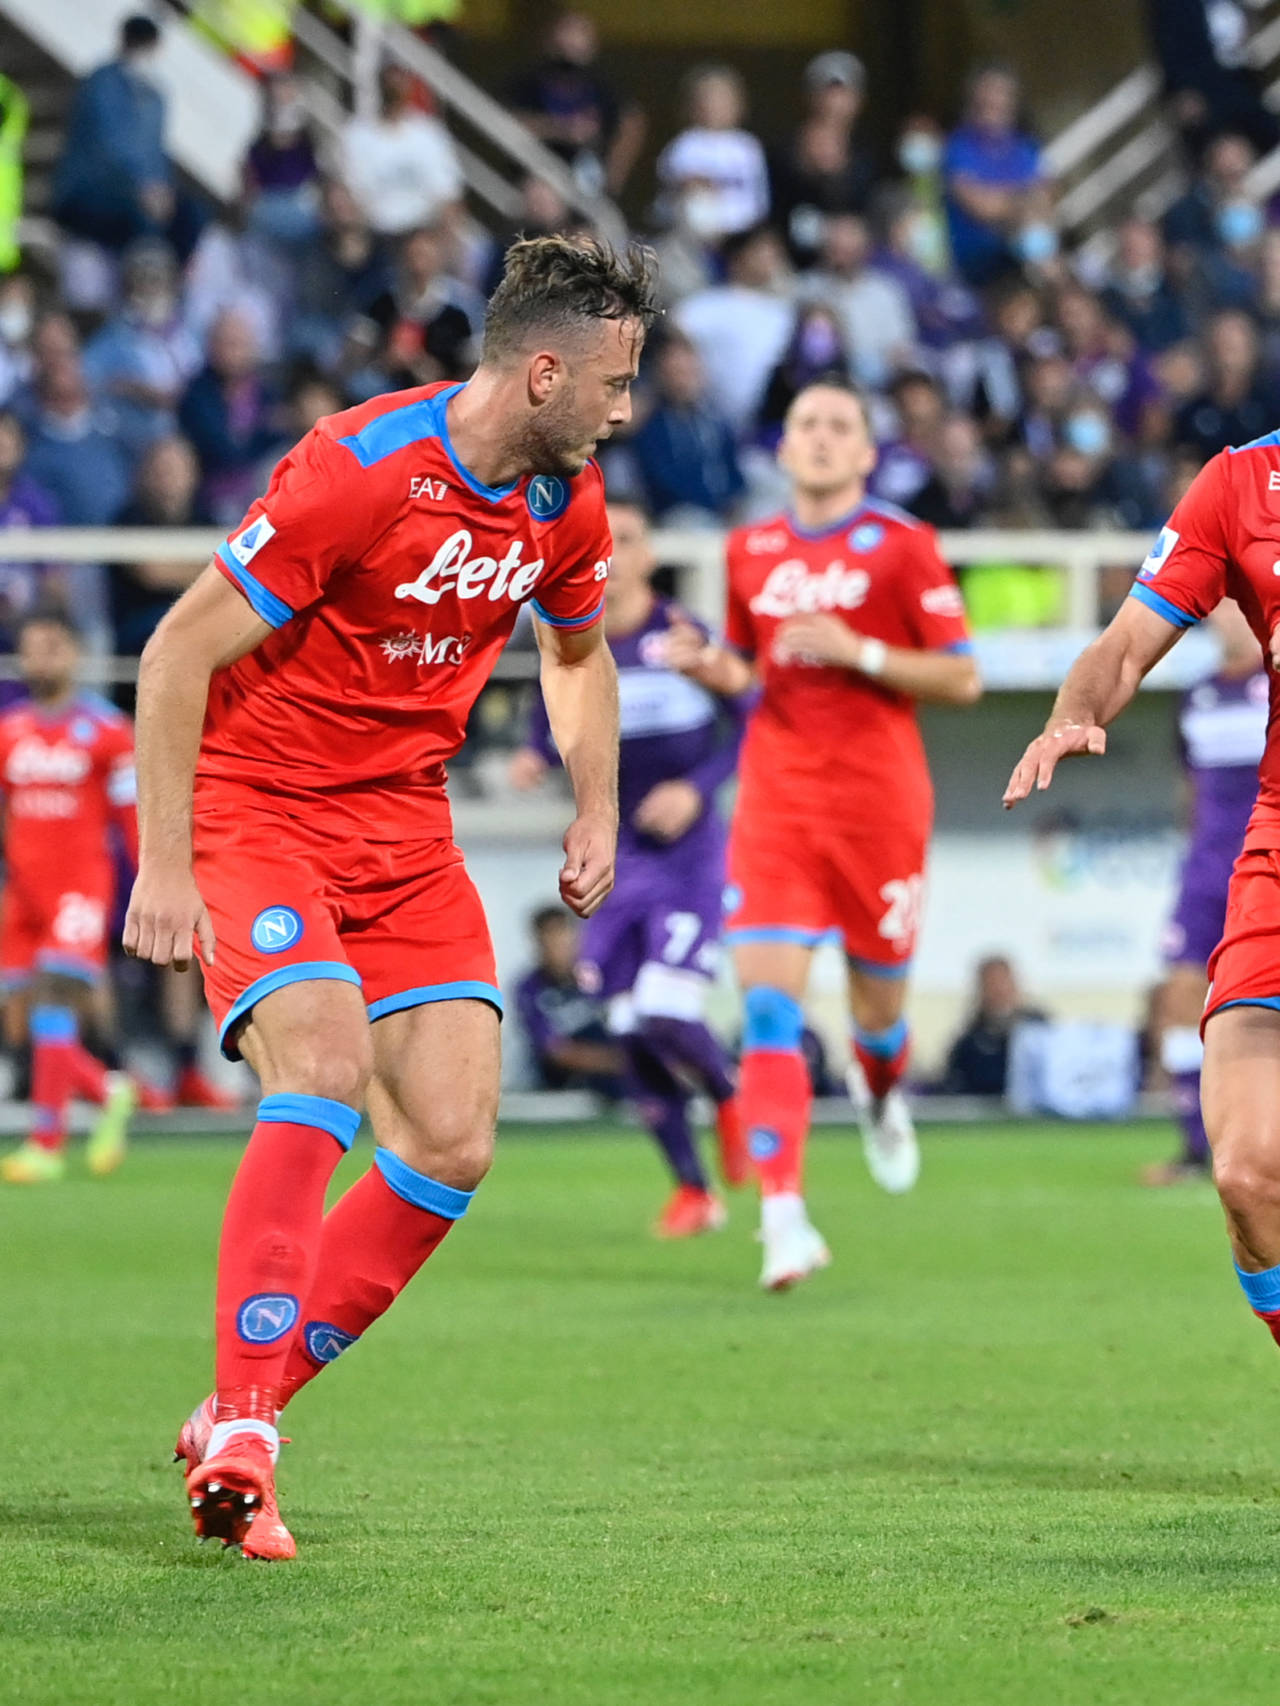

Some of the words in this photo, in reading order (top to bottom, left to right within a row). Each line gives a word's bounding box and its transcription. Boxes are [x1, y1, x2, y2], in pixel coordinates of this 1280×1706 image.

[408, 476, 449, 501] EA7
[532, 480, 557, 508] N
[394, 529, 545, 605] Lete
[262, 914, 288, 943] N
[253, 1305, 287, 1333] N
